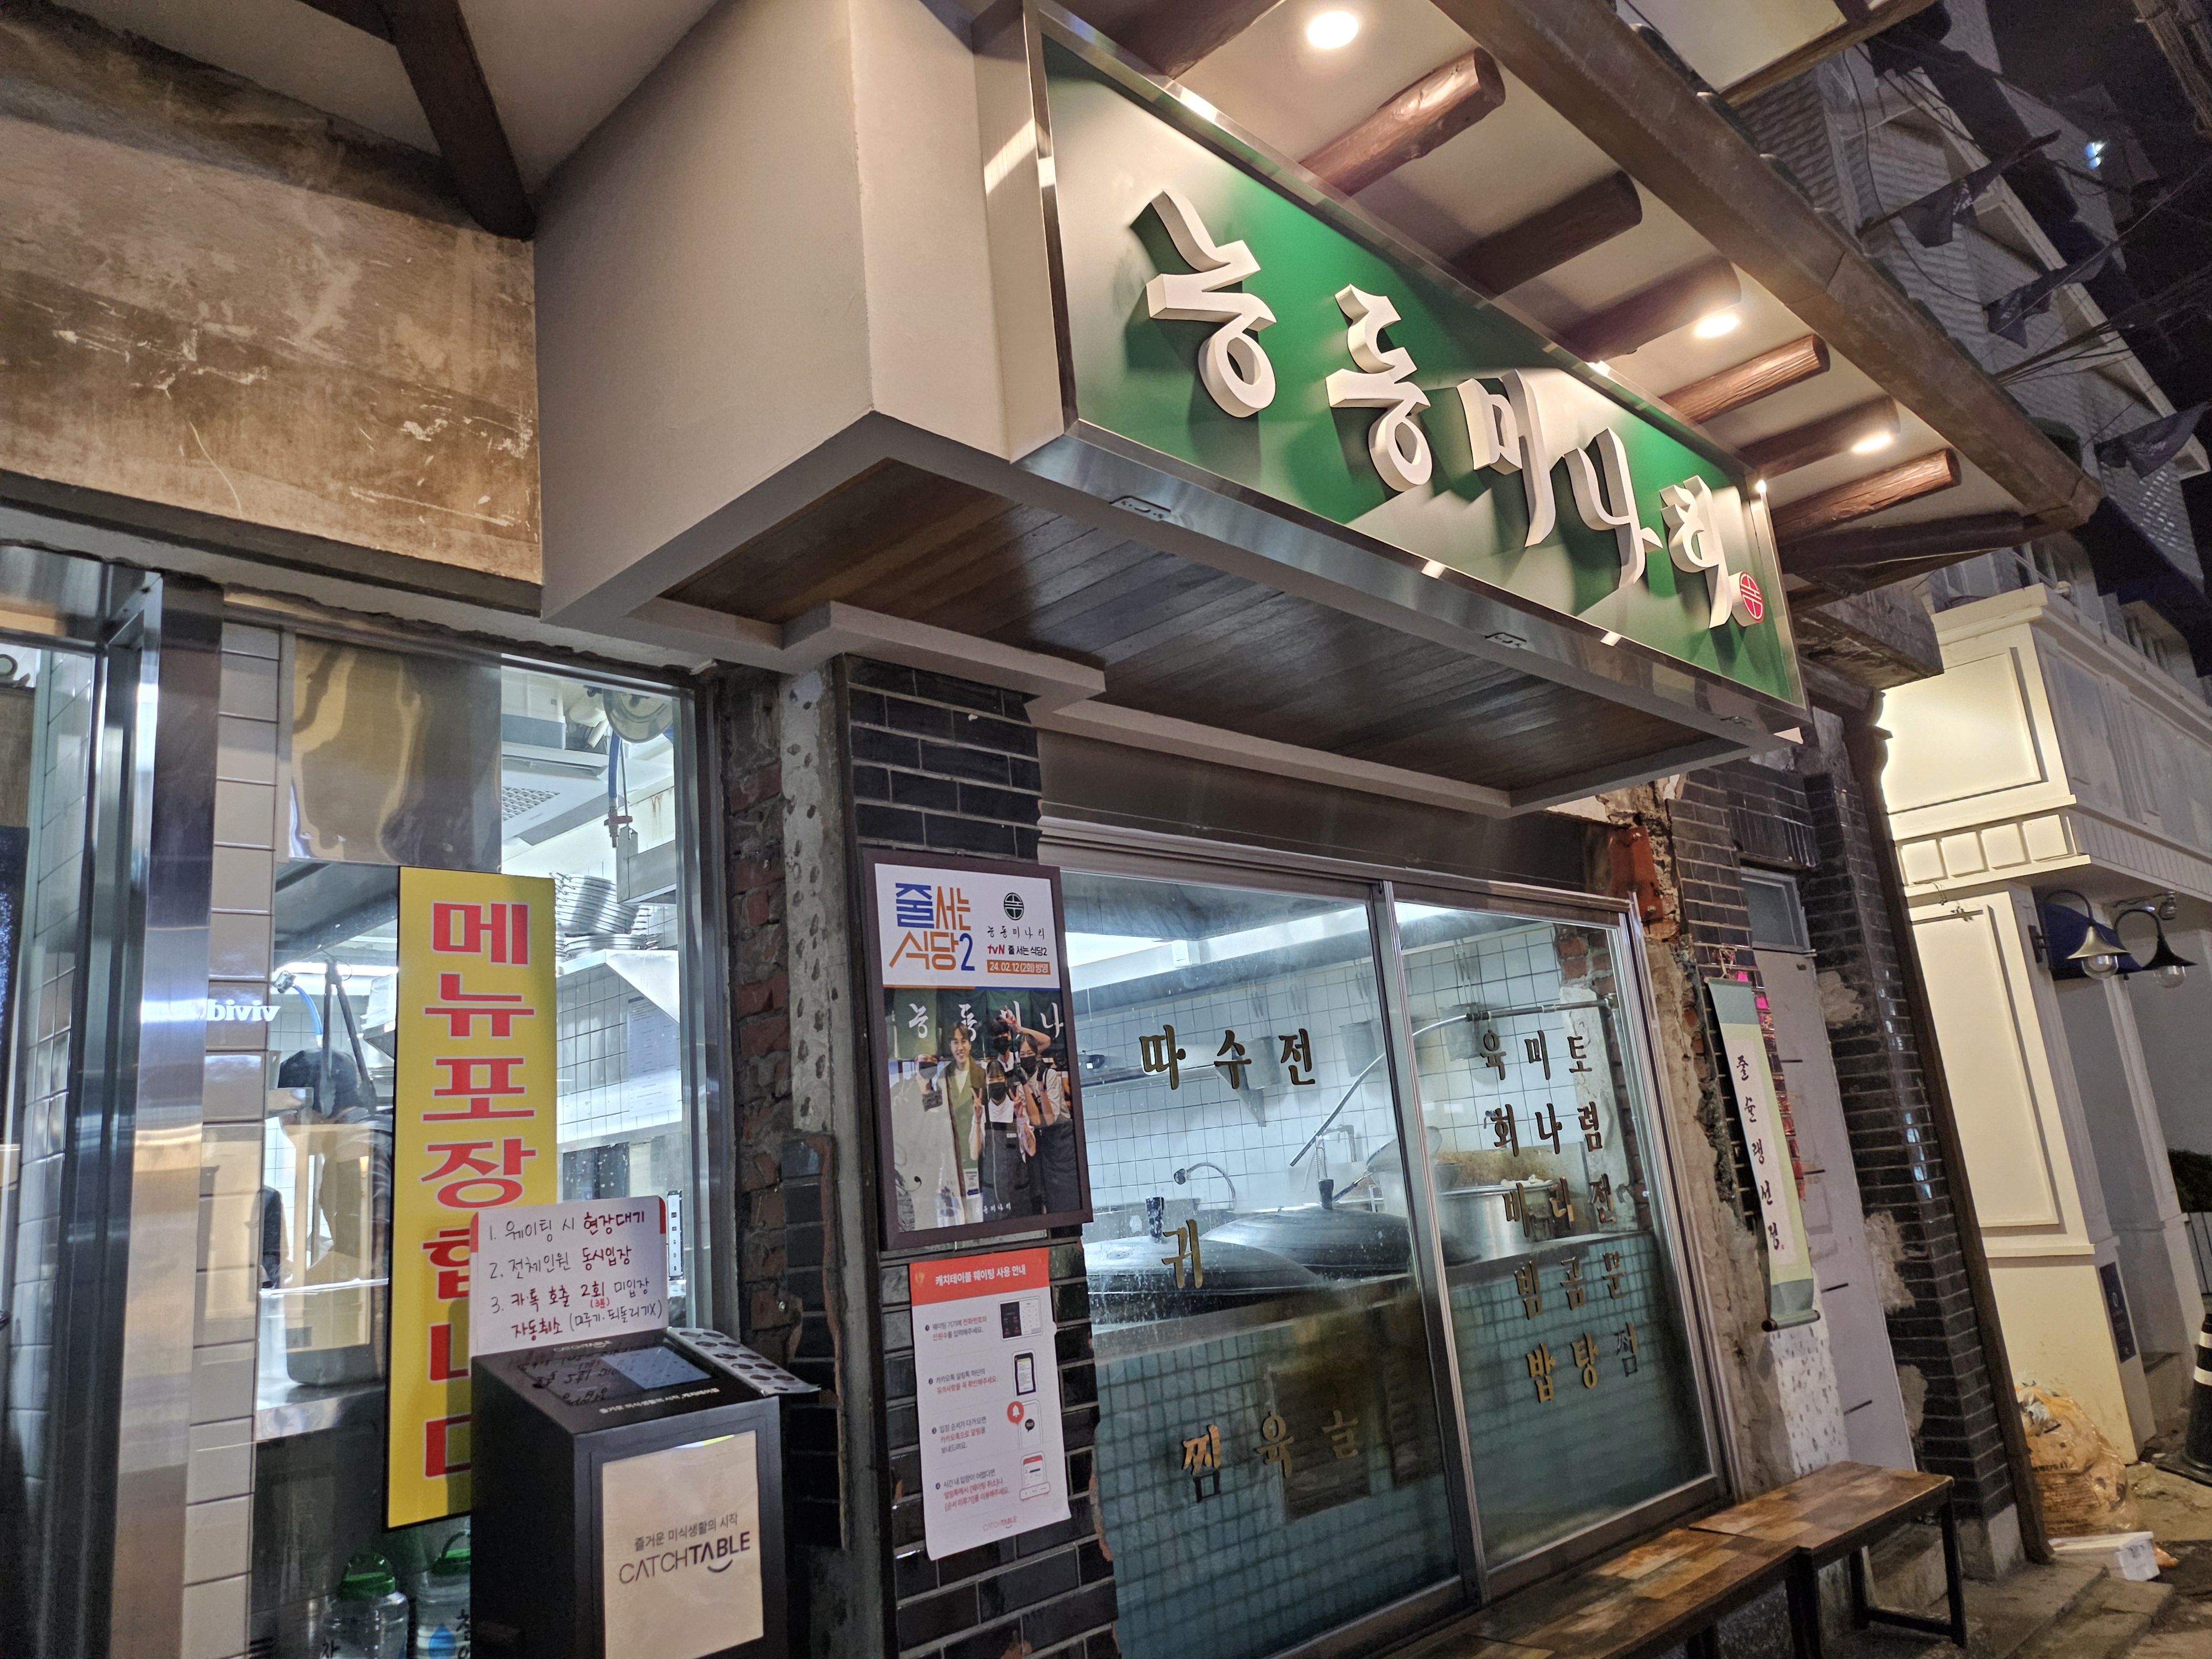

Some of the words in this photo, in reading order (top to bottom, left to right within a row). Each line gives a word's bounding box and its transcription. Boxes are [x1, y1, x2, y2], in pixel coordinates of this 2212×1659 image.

[1146, 189, 1732, 629] 능동미나리
[895, 882, 972, 931] 줄서는
[987, 925, 1045, 940] 능동미나리
[987, 944, 1005, 954] tvN
[1030, 946, 1048, 956] 식당2
[888, 930, 975, 972] 식당2
[489, 1225, 497, 1241] 1.
[562, 1217, 575, 1232] 시
[583, 1211, 645, 1235] 현장대기
[489, 1262, 504, 1279] 2.
[508, 1251, 572, 1279] 전체인원
[582, 1245, 633, 1271] 동시입장
[935, 1270, 973, 1287] 캐치테이블
[973, 1267, 995, 1281] 웨이팅
[997, 1266, 1011, 1279] 사용
[1011, 1264, 1026, 1275] 안내
[491, 1296, 504, 1314] 3.
[548, 1284, 571, 1307] 호출
[581, 1280, 605, 1298] 2회
[614, 1277, 650, 1299] 미입장
[511, 1316, 564, 1342] 자동취소
[634, 1531, 665, 1552] 즐거운
[668, 1518, 717, 1542] 미식생활의
[720, 1512, 739, 1528] 시작
[619, 1531, 751, 1584] CATCHTABLE
